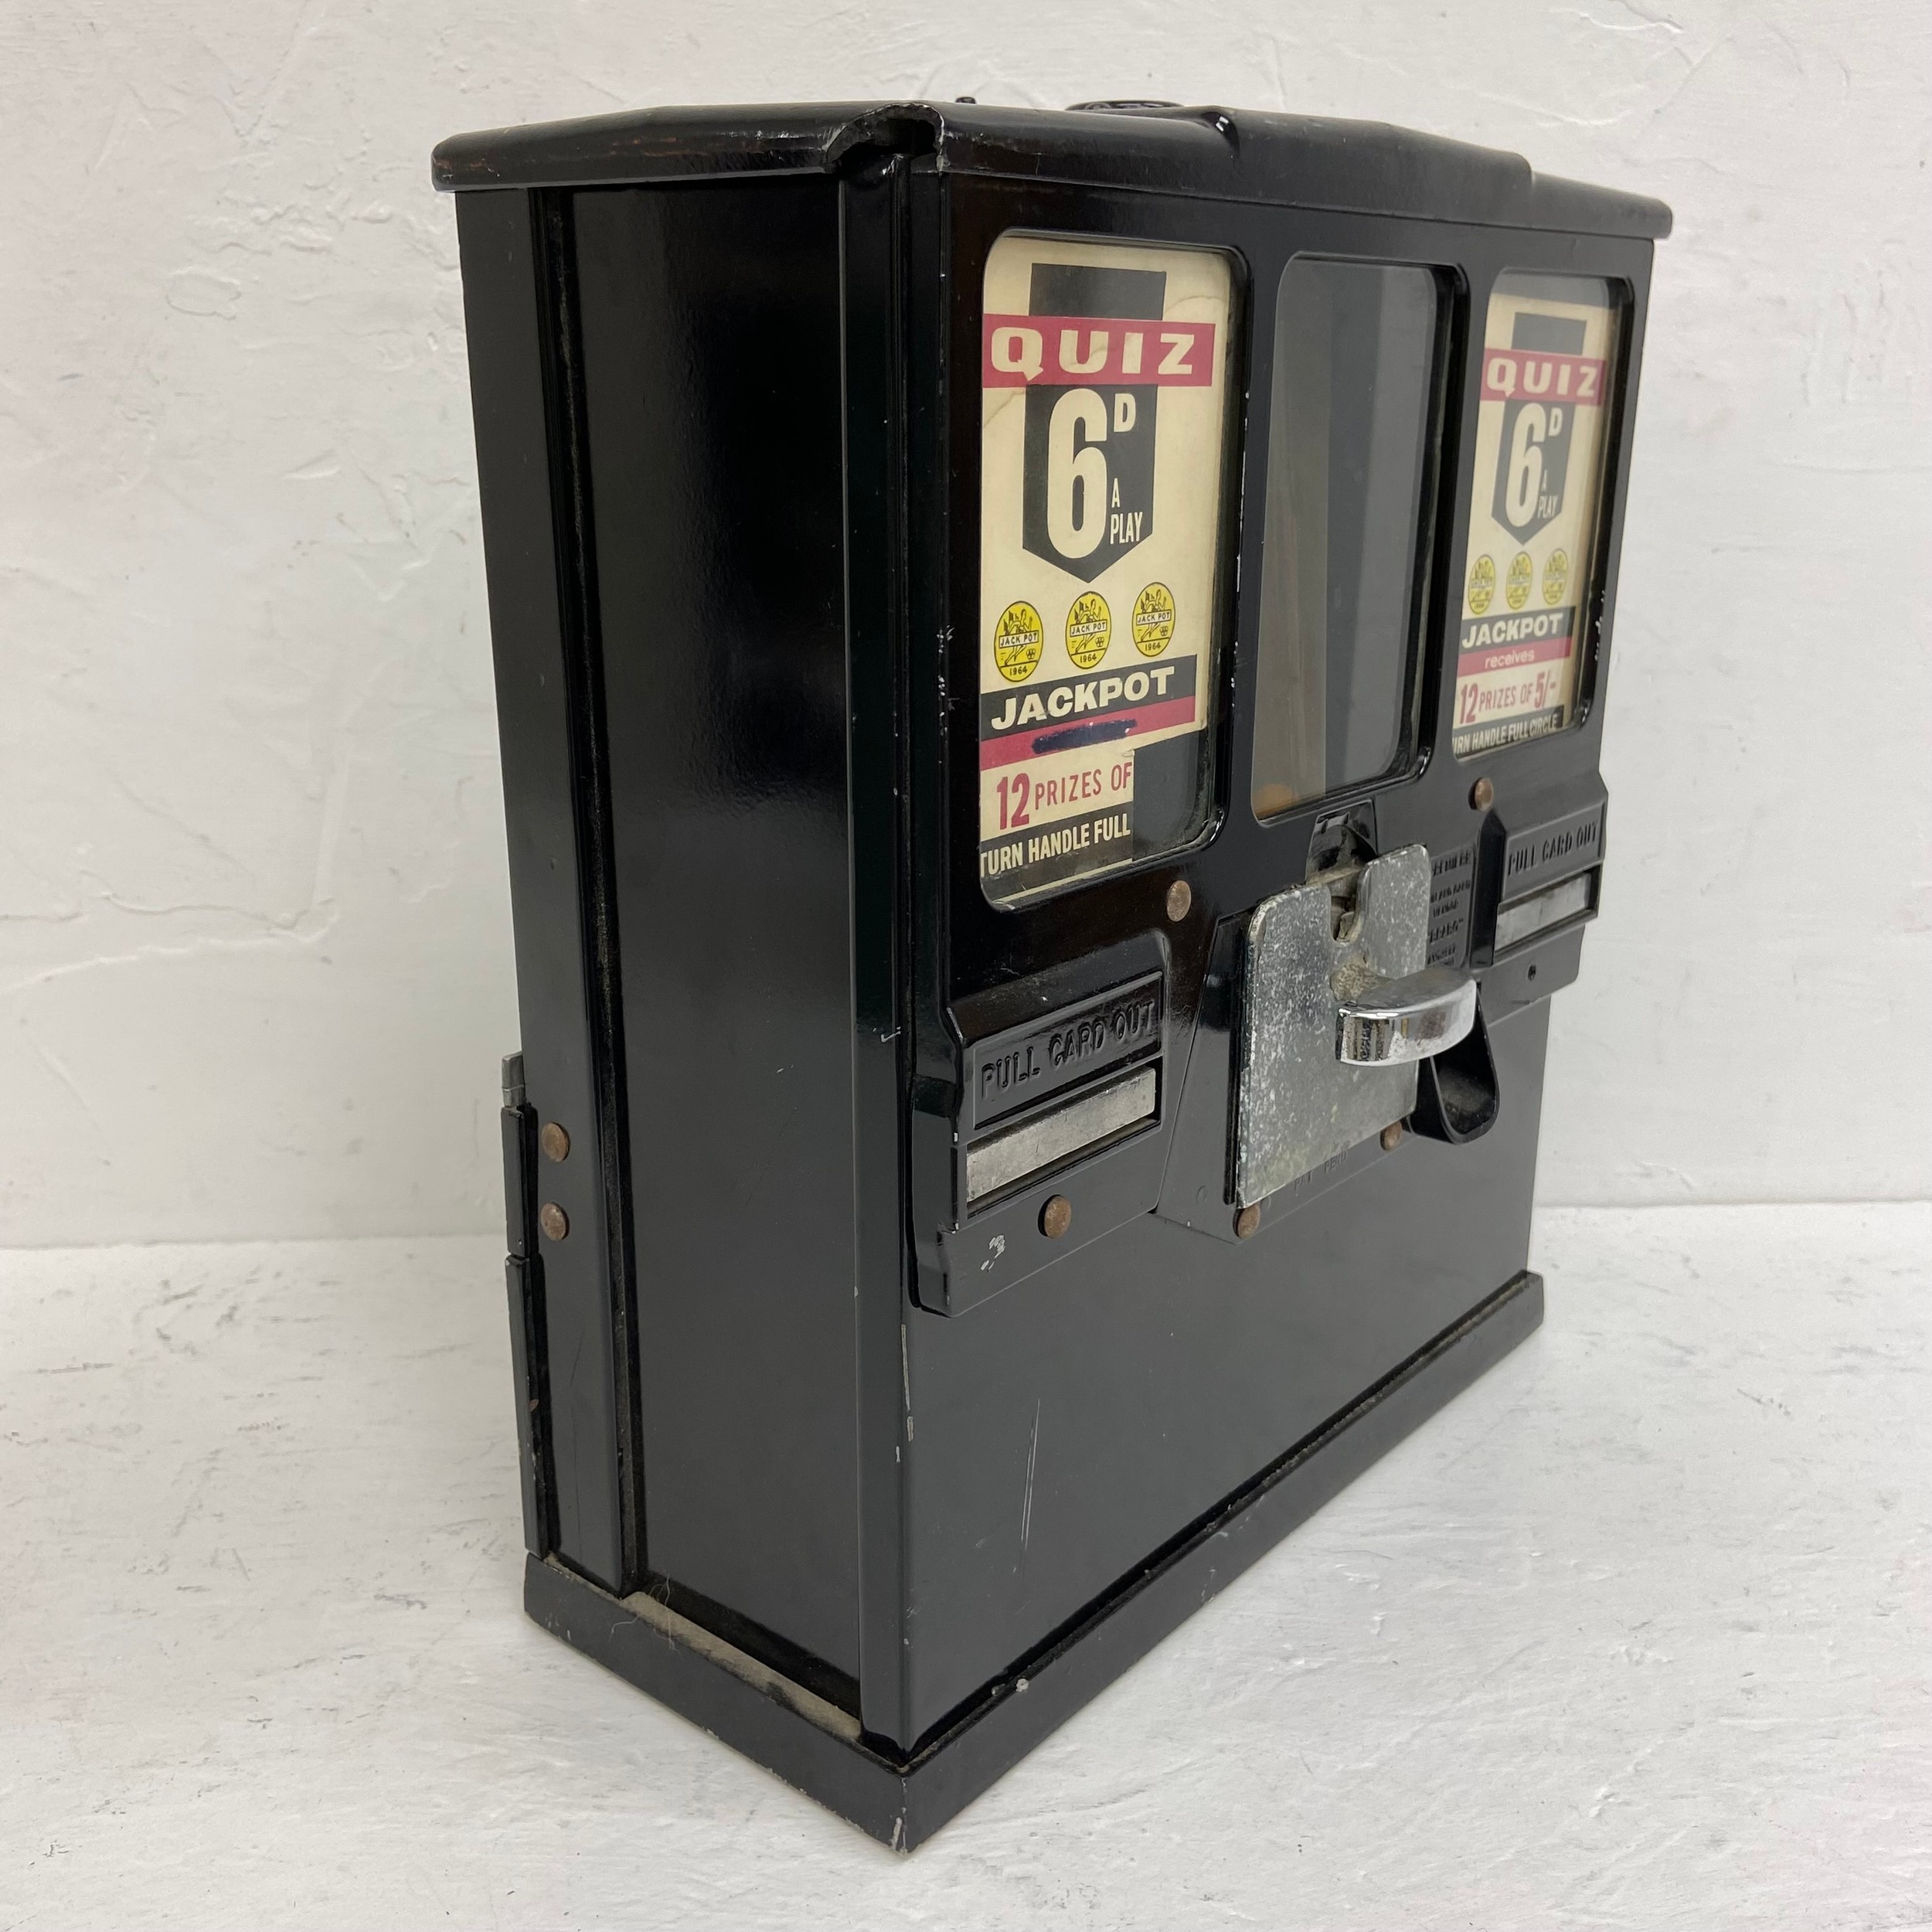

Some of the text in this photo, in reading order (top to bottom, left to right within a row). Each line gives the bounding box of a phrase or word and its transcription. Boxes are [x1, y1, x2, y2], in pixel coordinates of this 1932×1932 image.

[991, 327, 1195, 381] QUIZ
[1486, 357, 1598, 397] QUIZ
[1111, 478, 1121, 508] A
[1537, 495, 1558, 519] PLAY
[1110, 512, 1143, 545] PLAY
[1071, 621, 1106, 634] JACK POT
[1138, 611, 1170, 623] JACK POT
[1461, 614, 1563, 648] JACKPOT
[1000, 632, 1037, 647] JACK POT
[1145, 641, 1162, 651] 1964
[1009, 665, 1028, 676] 1964
[1080, 653, 1097, 663] 1964
[1485, 649, 1535, 669] receives
[991, 666, 1175, 730] JACKPOT
[1459, 683, 1478, 724] 12
[1478, 685, 1515, 713] PRIZES
[1520, 683, 1533, 705] OF
[1471, 725, 1507, 750] HANDLE
[1508, 719, 1529, 742] FULL
[1529, 713, 1559, 736] CIRCLE
[996, 761, 1133, 830] 12 PRIZES OF
[1029, 822, 1090, 863] HANDLE
[1094, 813, 1131, 844] FULL
[1508, 845, 1536, 876] PULL
[1542, 832, 1573, 862] CARD
[1577, 821, 1598, 846] OUT
[981, 1000, 1155, 1099] PULL CARD OUT
